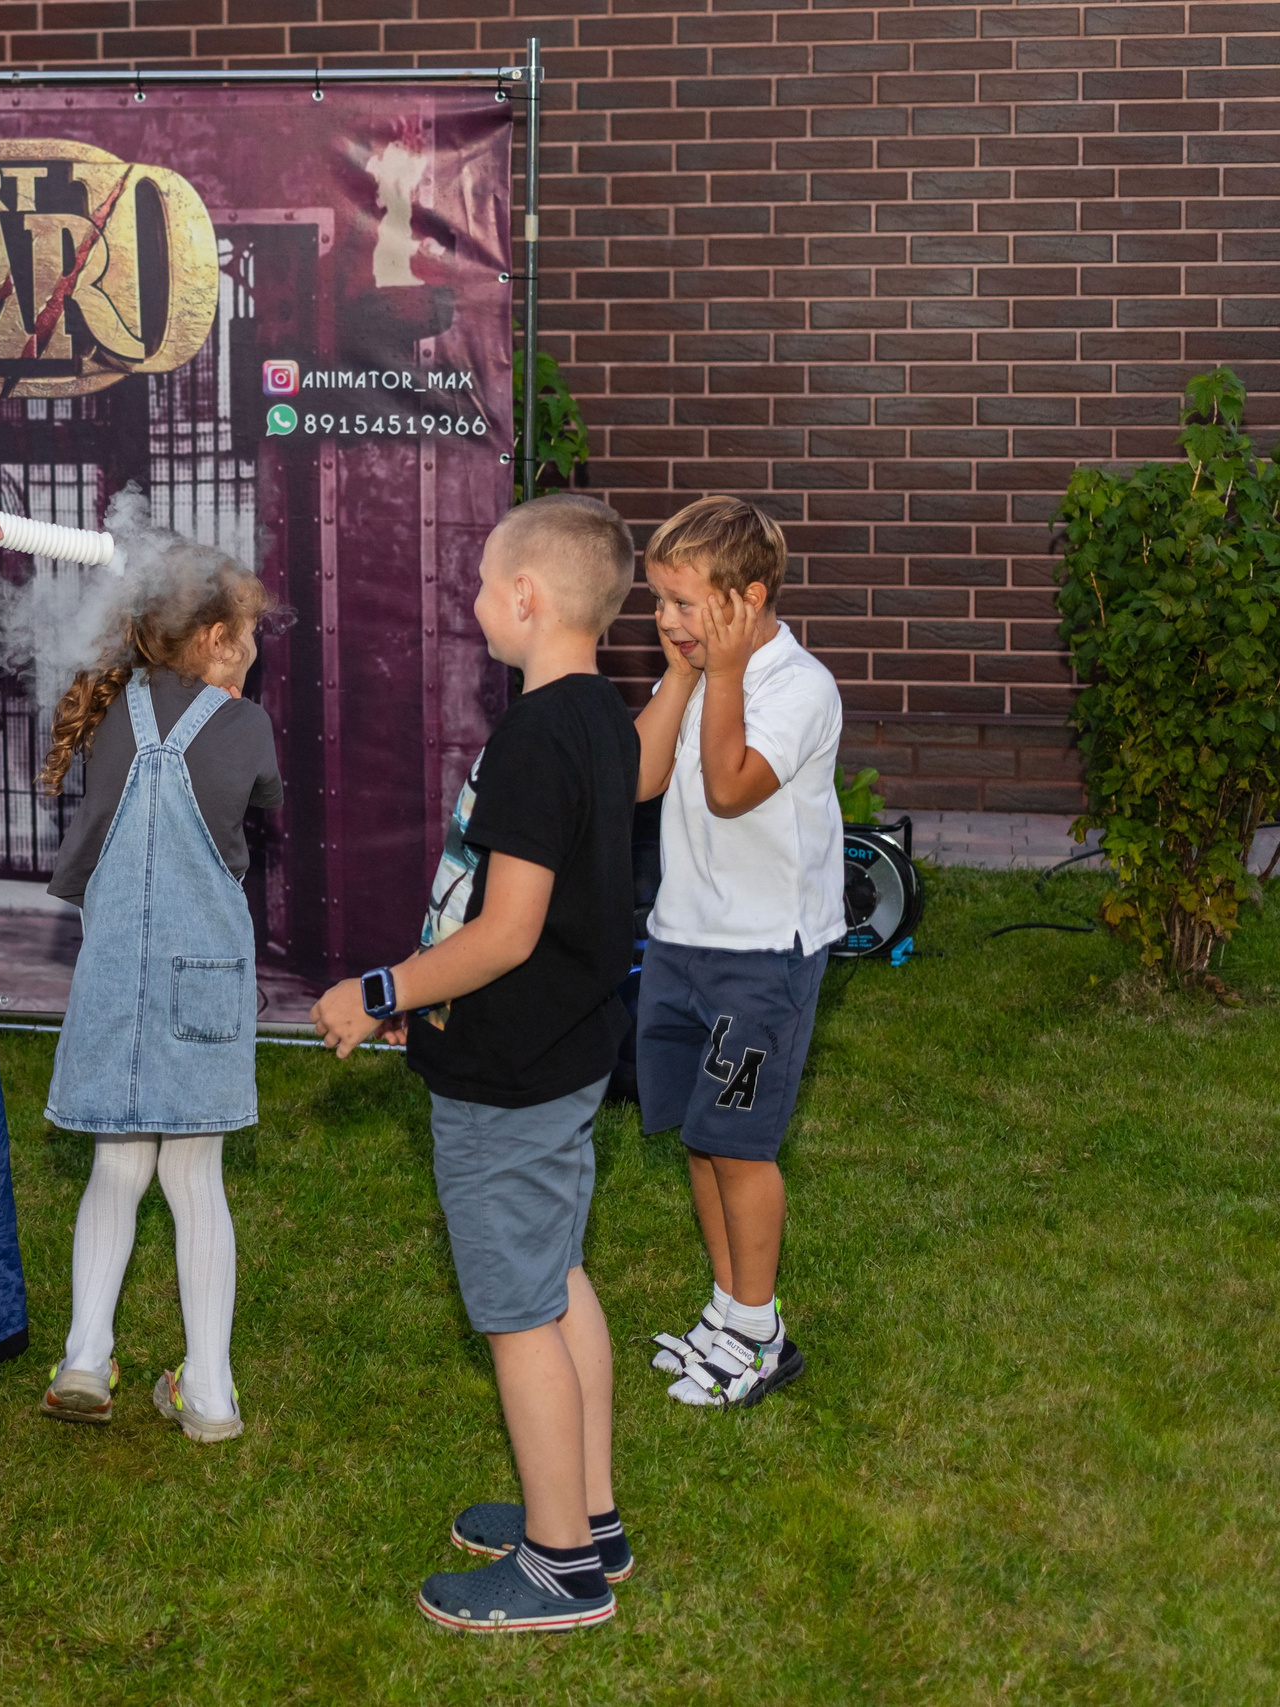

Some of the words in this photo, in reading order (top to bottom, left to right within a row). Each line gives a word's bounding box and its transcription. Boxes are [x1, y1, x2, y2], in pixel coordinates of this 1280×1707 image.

[302, 371, 474, 393] ANIMATOR_MAX
[303, 413, 487, 436] 89154519366
[725, 1339, 753, 1361] MUTONG
